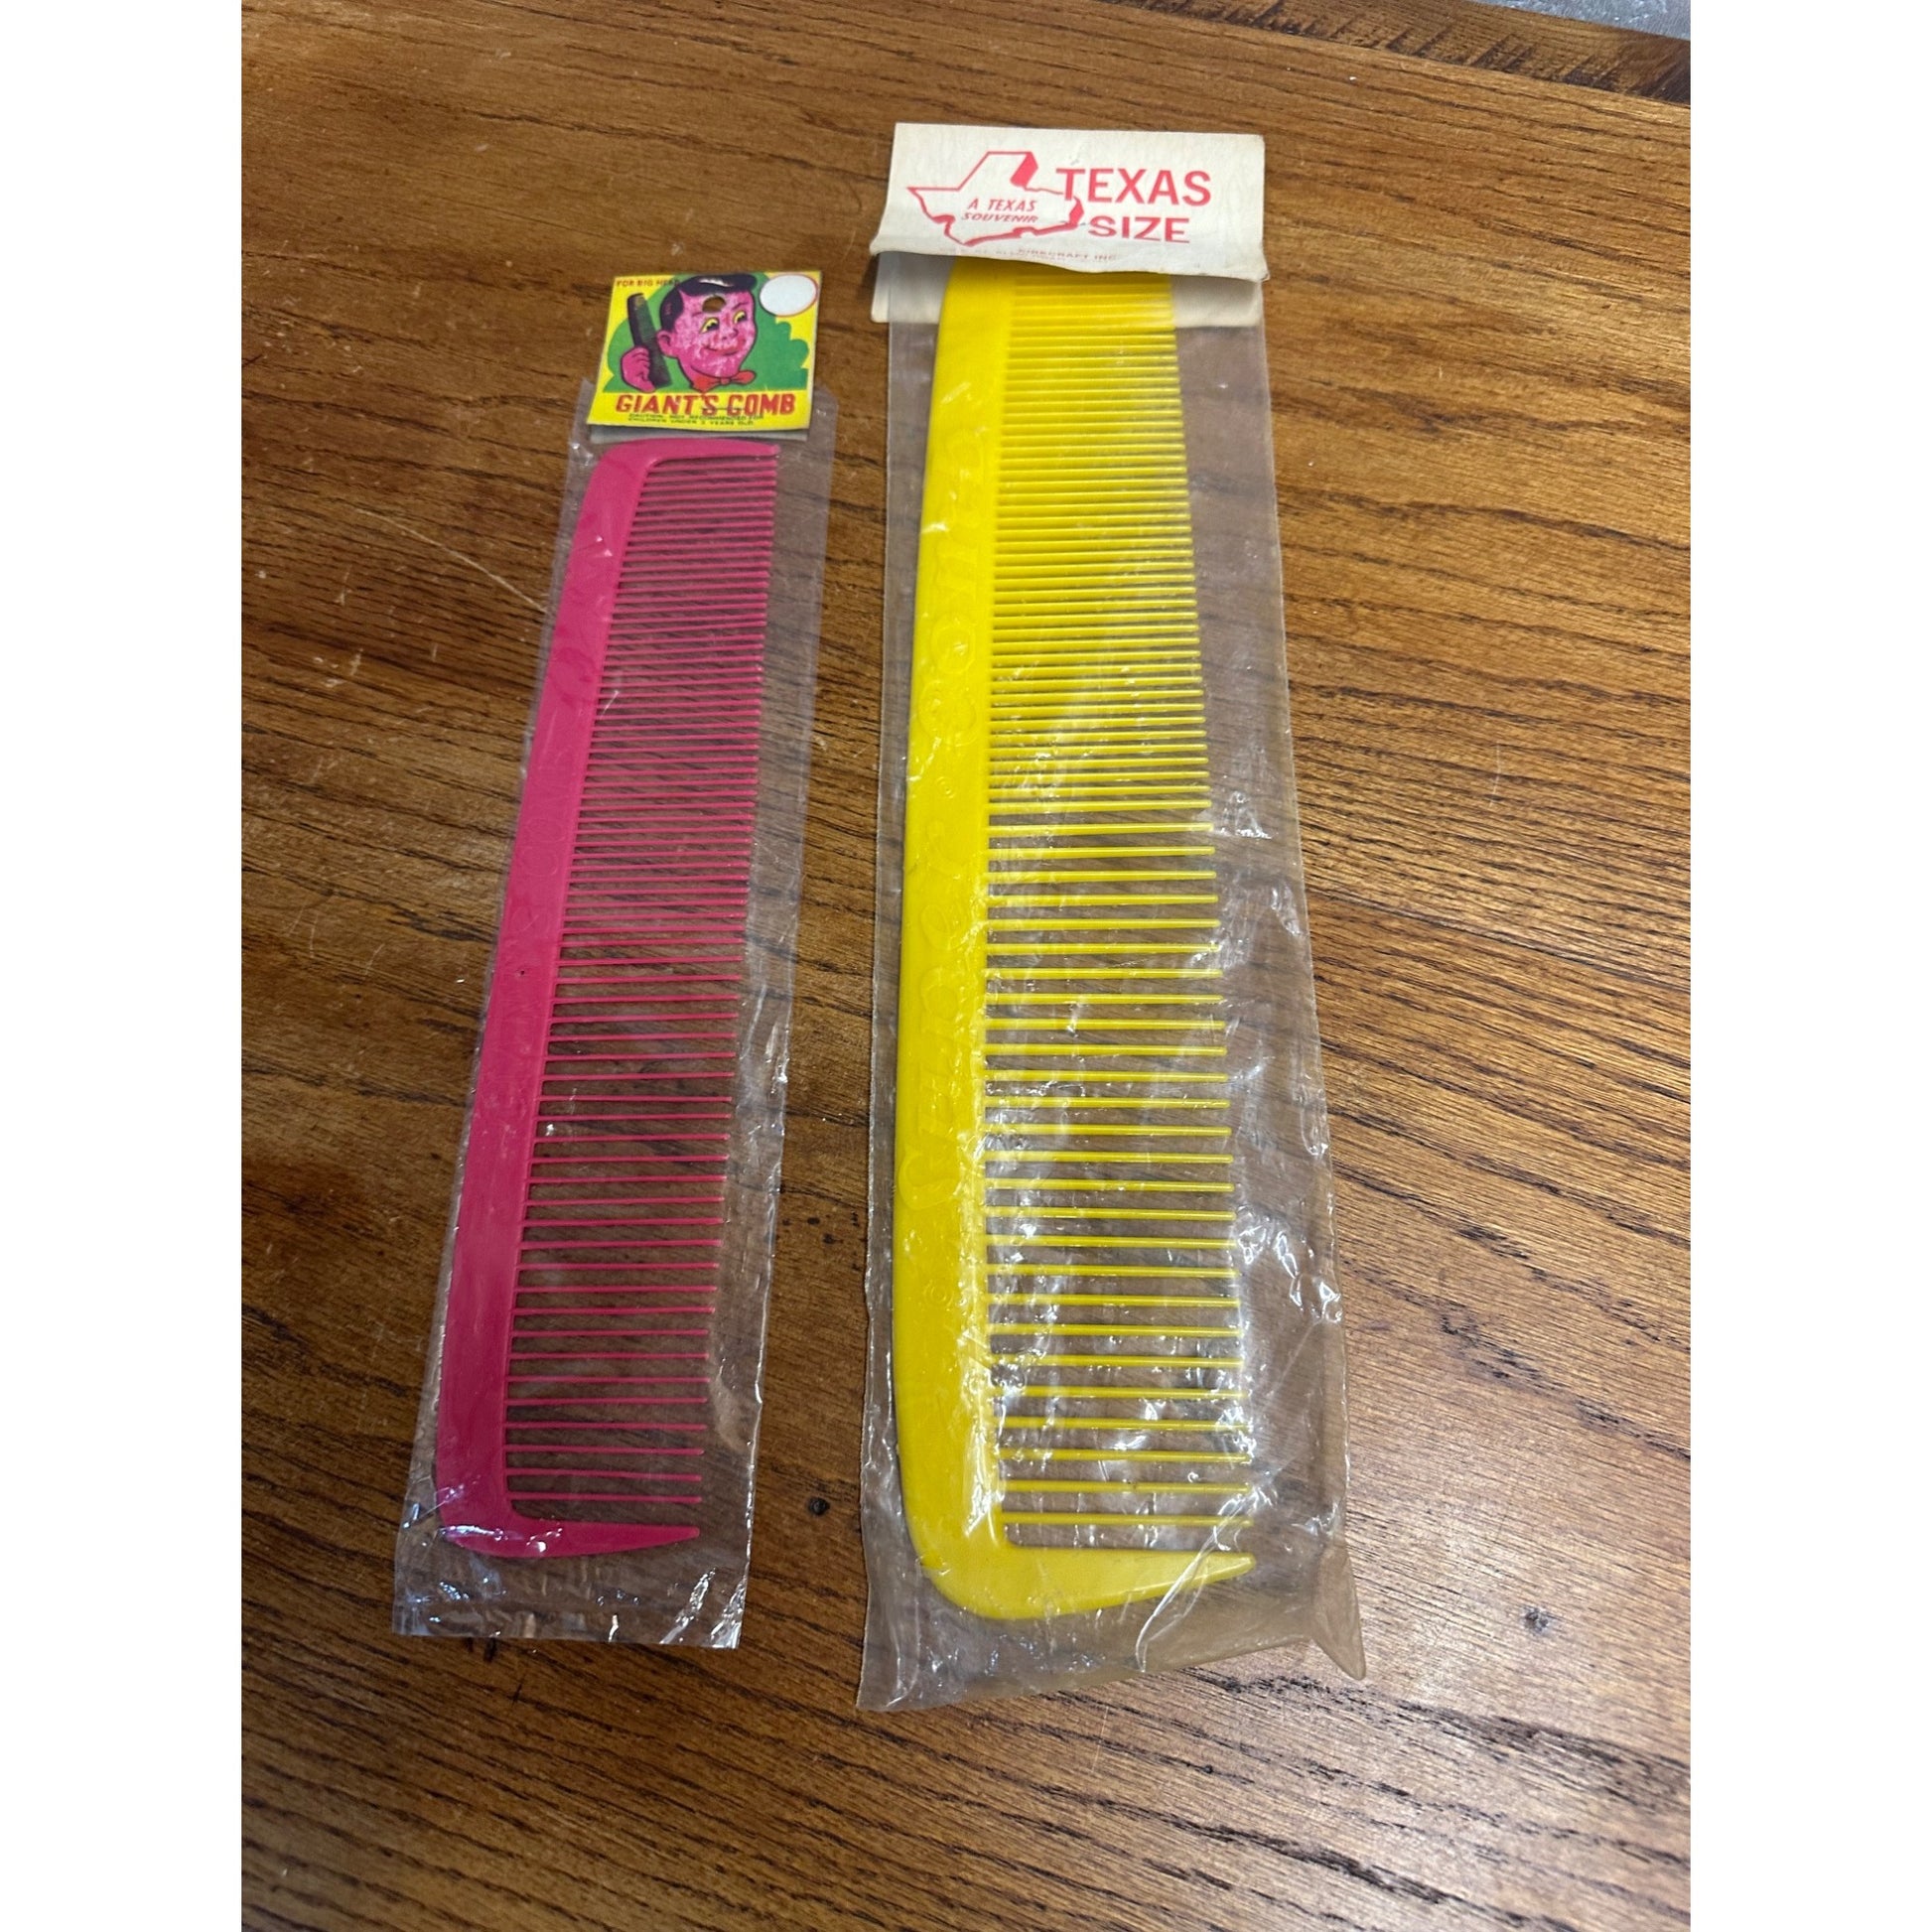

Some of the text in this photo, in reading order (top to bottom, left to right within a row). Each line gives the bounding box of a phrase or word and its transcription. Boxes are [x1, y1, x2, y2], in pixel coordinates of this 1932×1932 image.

[1055, 167, 1212, 207] TEXAS
[967, 198, 1037, 211] A TEXAS
[961, 211, 1038, 222] SOUVENIR
[1088, 215, 1190, 243] SIZE
[617, 279, 635, 288] FOR
[637, 279, 653, 288] BIG
[616, 393, 796, 417] GIANT'S COMB
